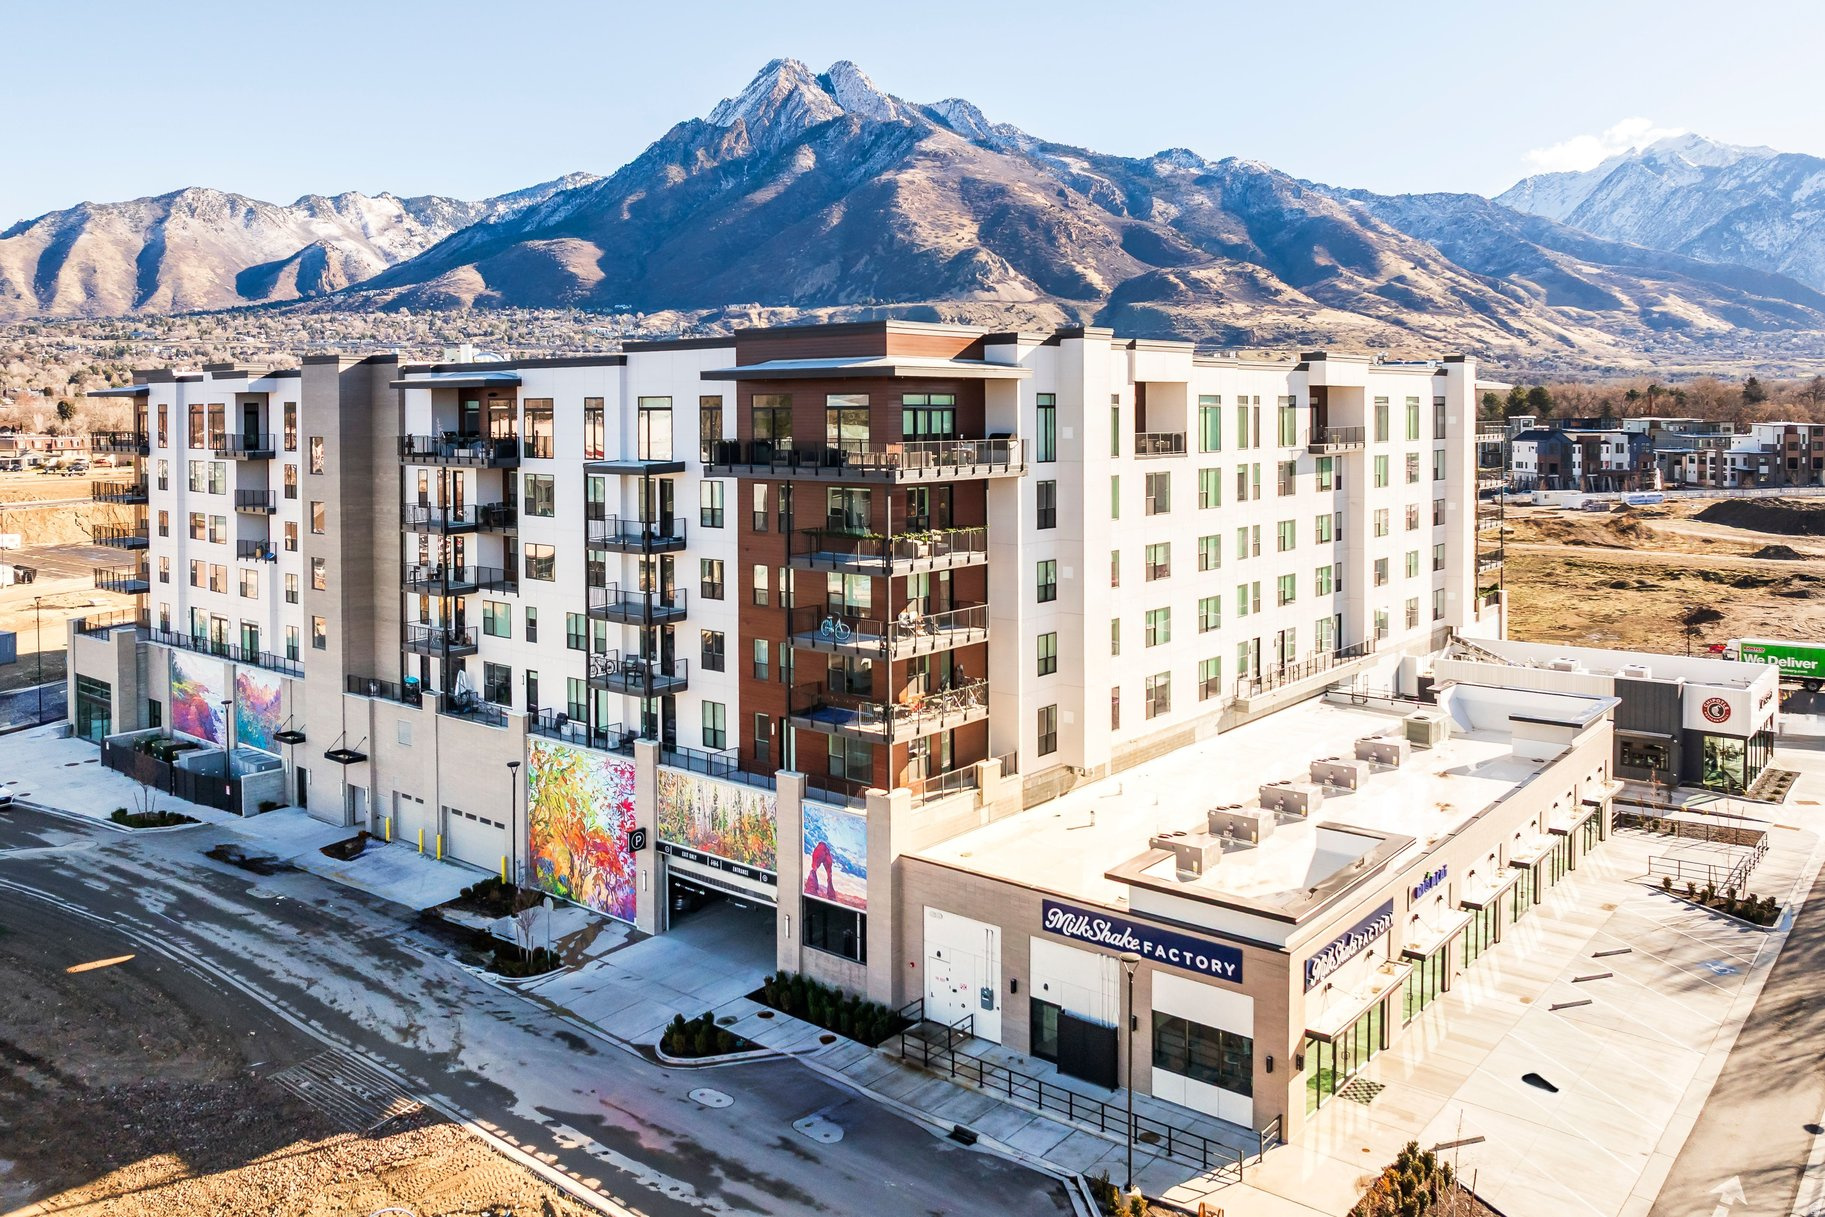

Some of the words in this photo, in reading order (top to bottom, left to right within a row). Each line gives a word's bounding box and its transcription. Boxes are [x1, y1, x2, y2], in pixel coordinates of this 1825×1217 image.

[1744, 653, 1766, 664] We
[1768, 656, 1818, 669] Deliver
[1703, 698, 1729, 710] CHIPOTLE
[635, 835, 642, 846] P
[1354, 911, 1393, 950] FACTORY
[1045, 908, 1140, 950] MilkShake
[1143, 941, 1236, 977] FACTORY
